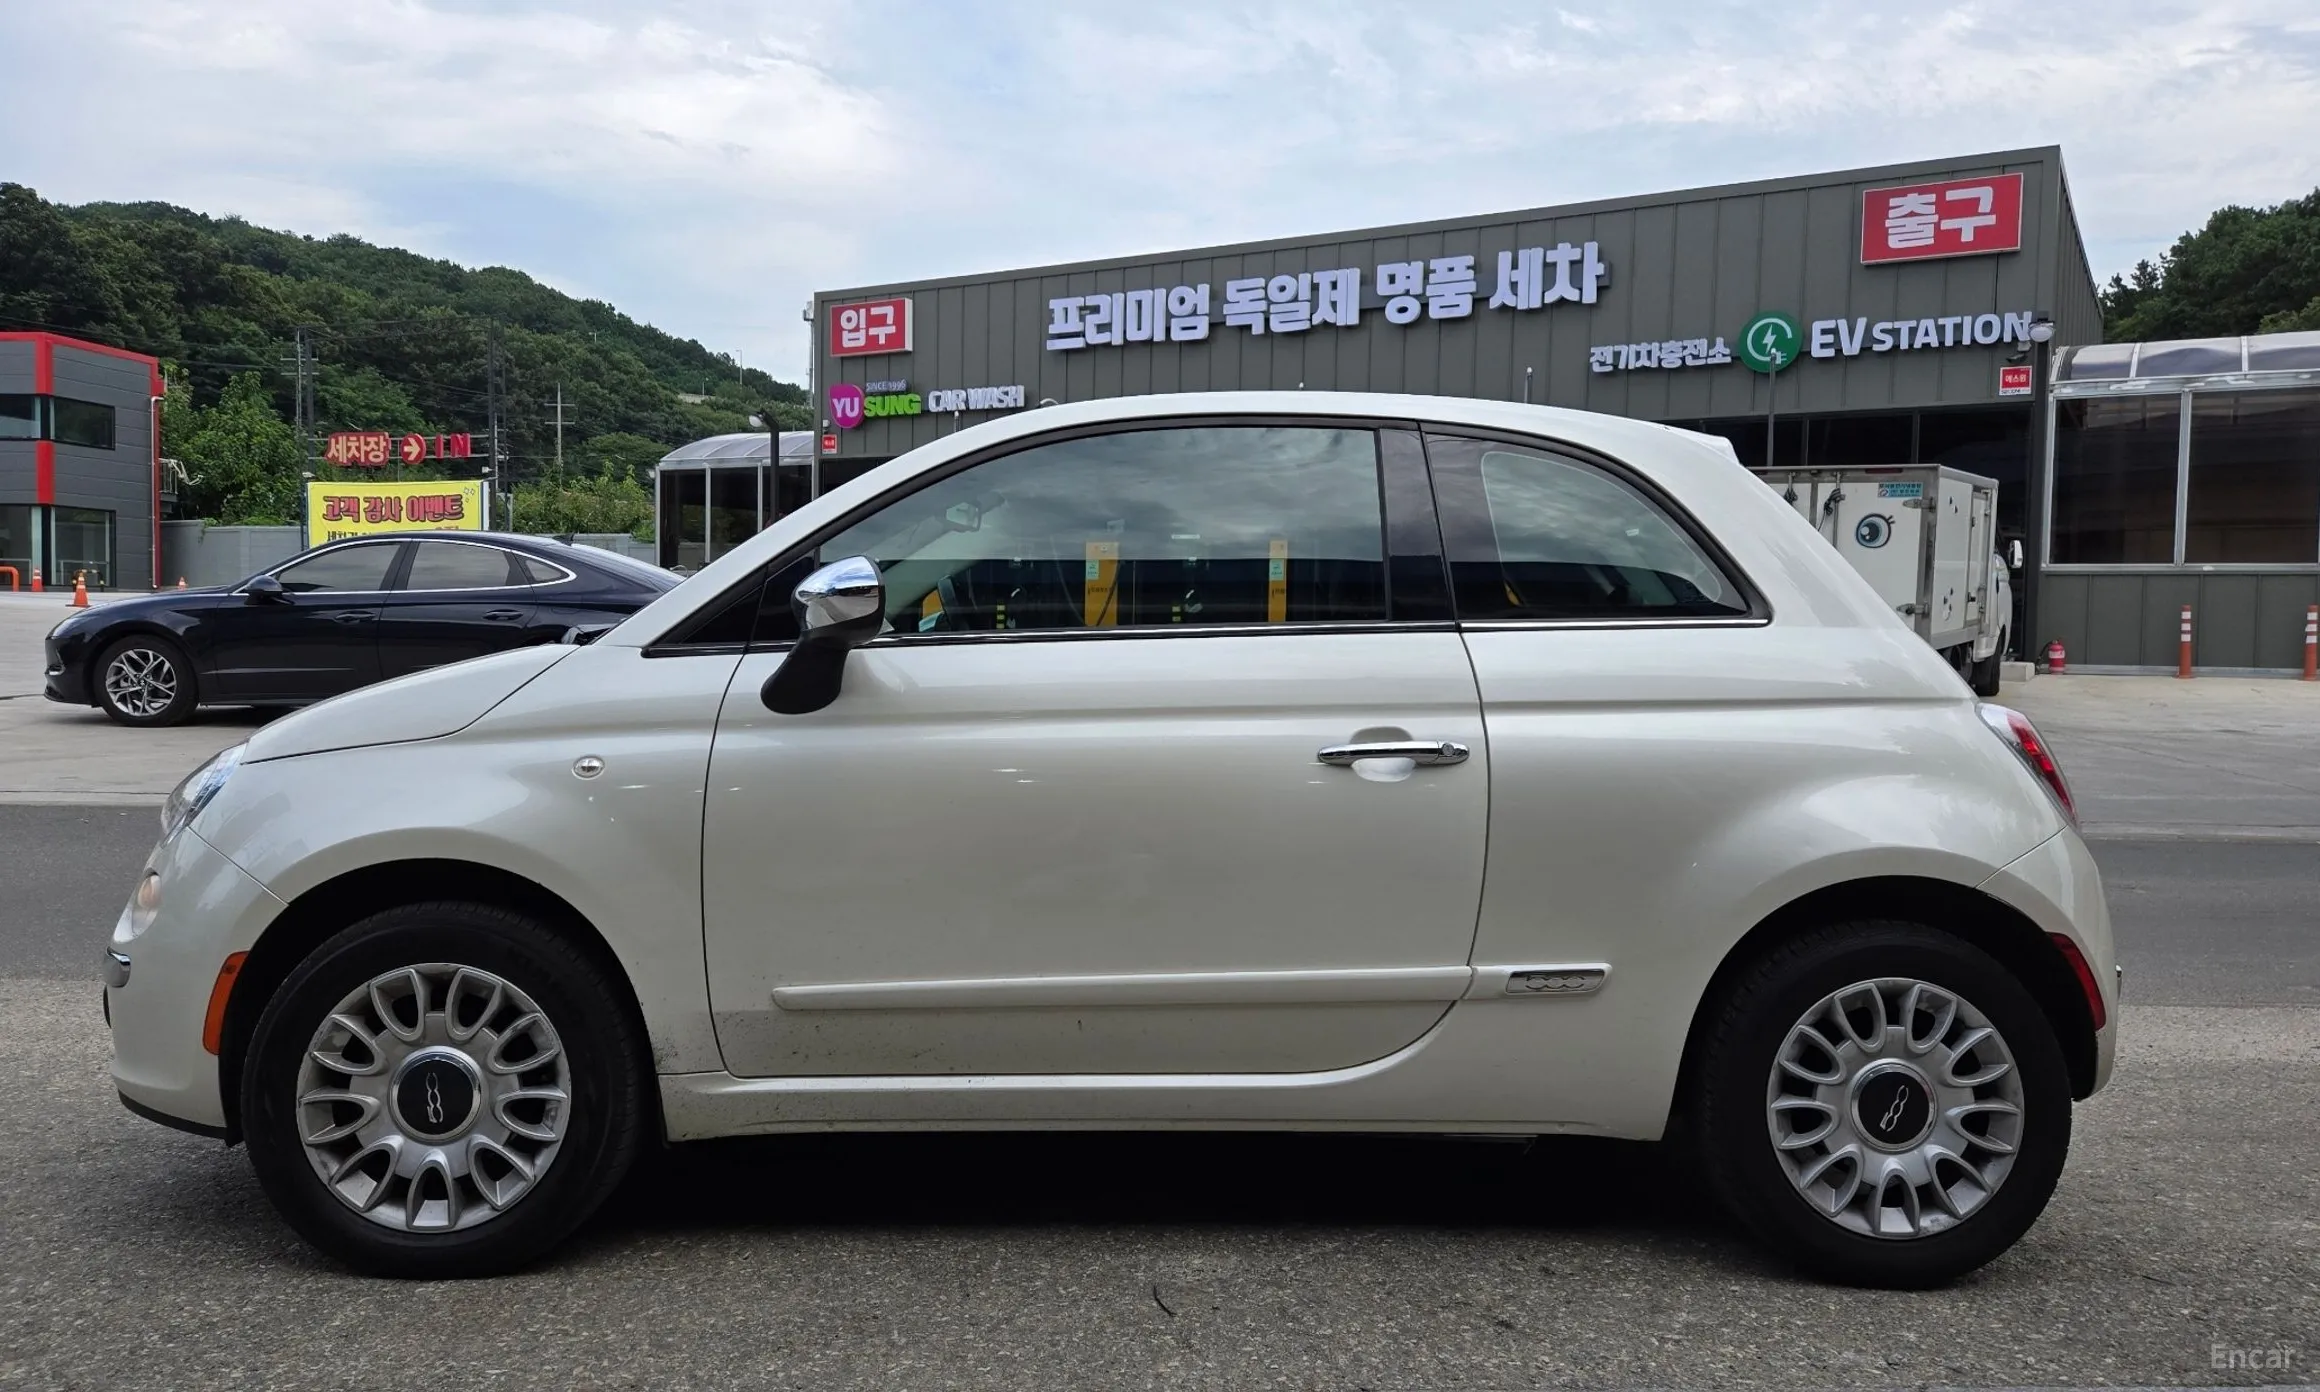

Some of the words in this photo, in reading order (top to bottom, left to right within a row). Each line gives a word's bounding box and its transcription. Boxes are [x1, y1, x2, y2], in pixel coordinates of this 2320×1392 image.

[1885, 185, 1997, 249] 출구
[1046, 283, 1210, 351] 프리미엄
[1222, 267, 1360, 335] 독일제
[1377, 255, 1477, 325] 명품
[1489, 241, 1604, 311] 세차
[840, 305, 896, 348] 입구
[1811, 317, 1867, 358] EV
[1872, 311, 2033, 352] STATION
[1589, 336, 1732, 373] 전기차충전소
[866, 381, 887, 391] SINCE
[928, 389, 966, 413] CAR
[967, 385, 1025, 409] WASH
[832, 397, 860, 418] YU
[864, 392, 922, 417] SUNG
[327, 434, 389, 465] 세차장
[434, 433, 471, 459] IN
[323, 495, 360, 522] 고객
[363, 495, 402, 523] 감사
[406, 494, 464, 522] 이벤트
